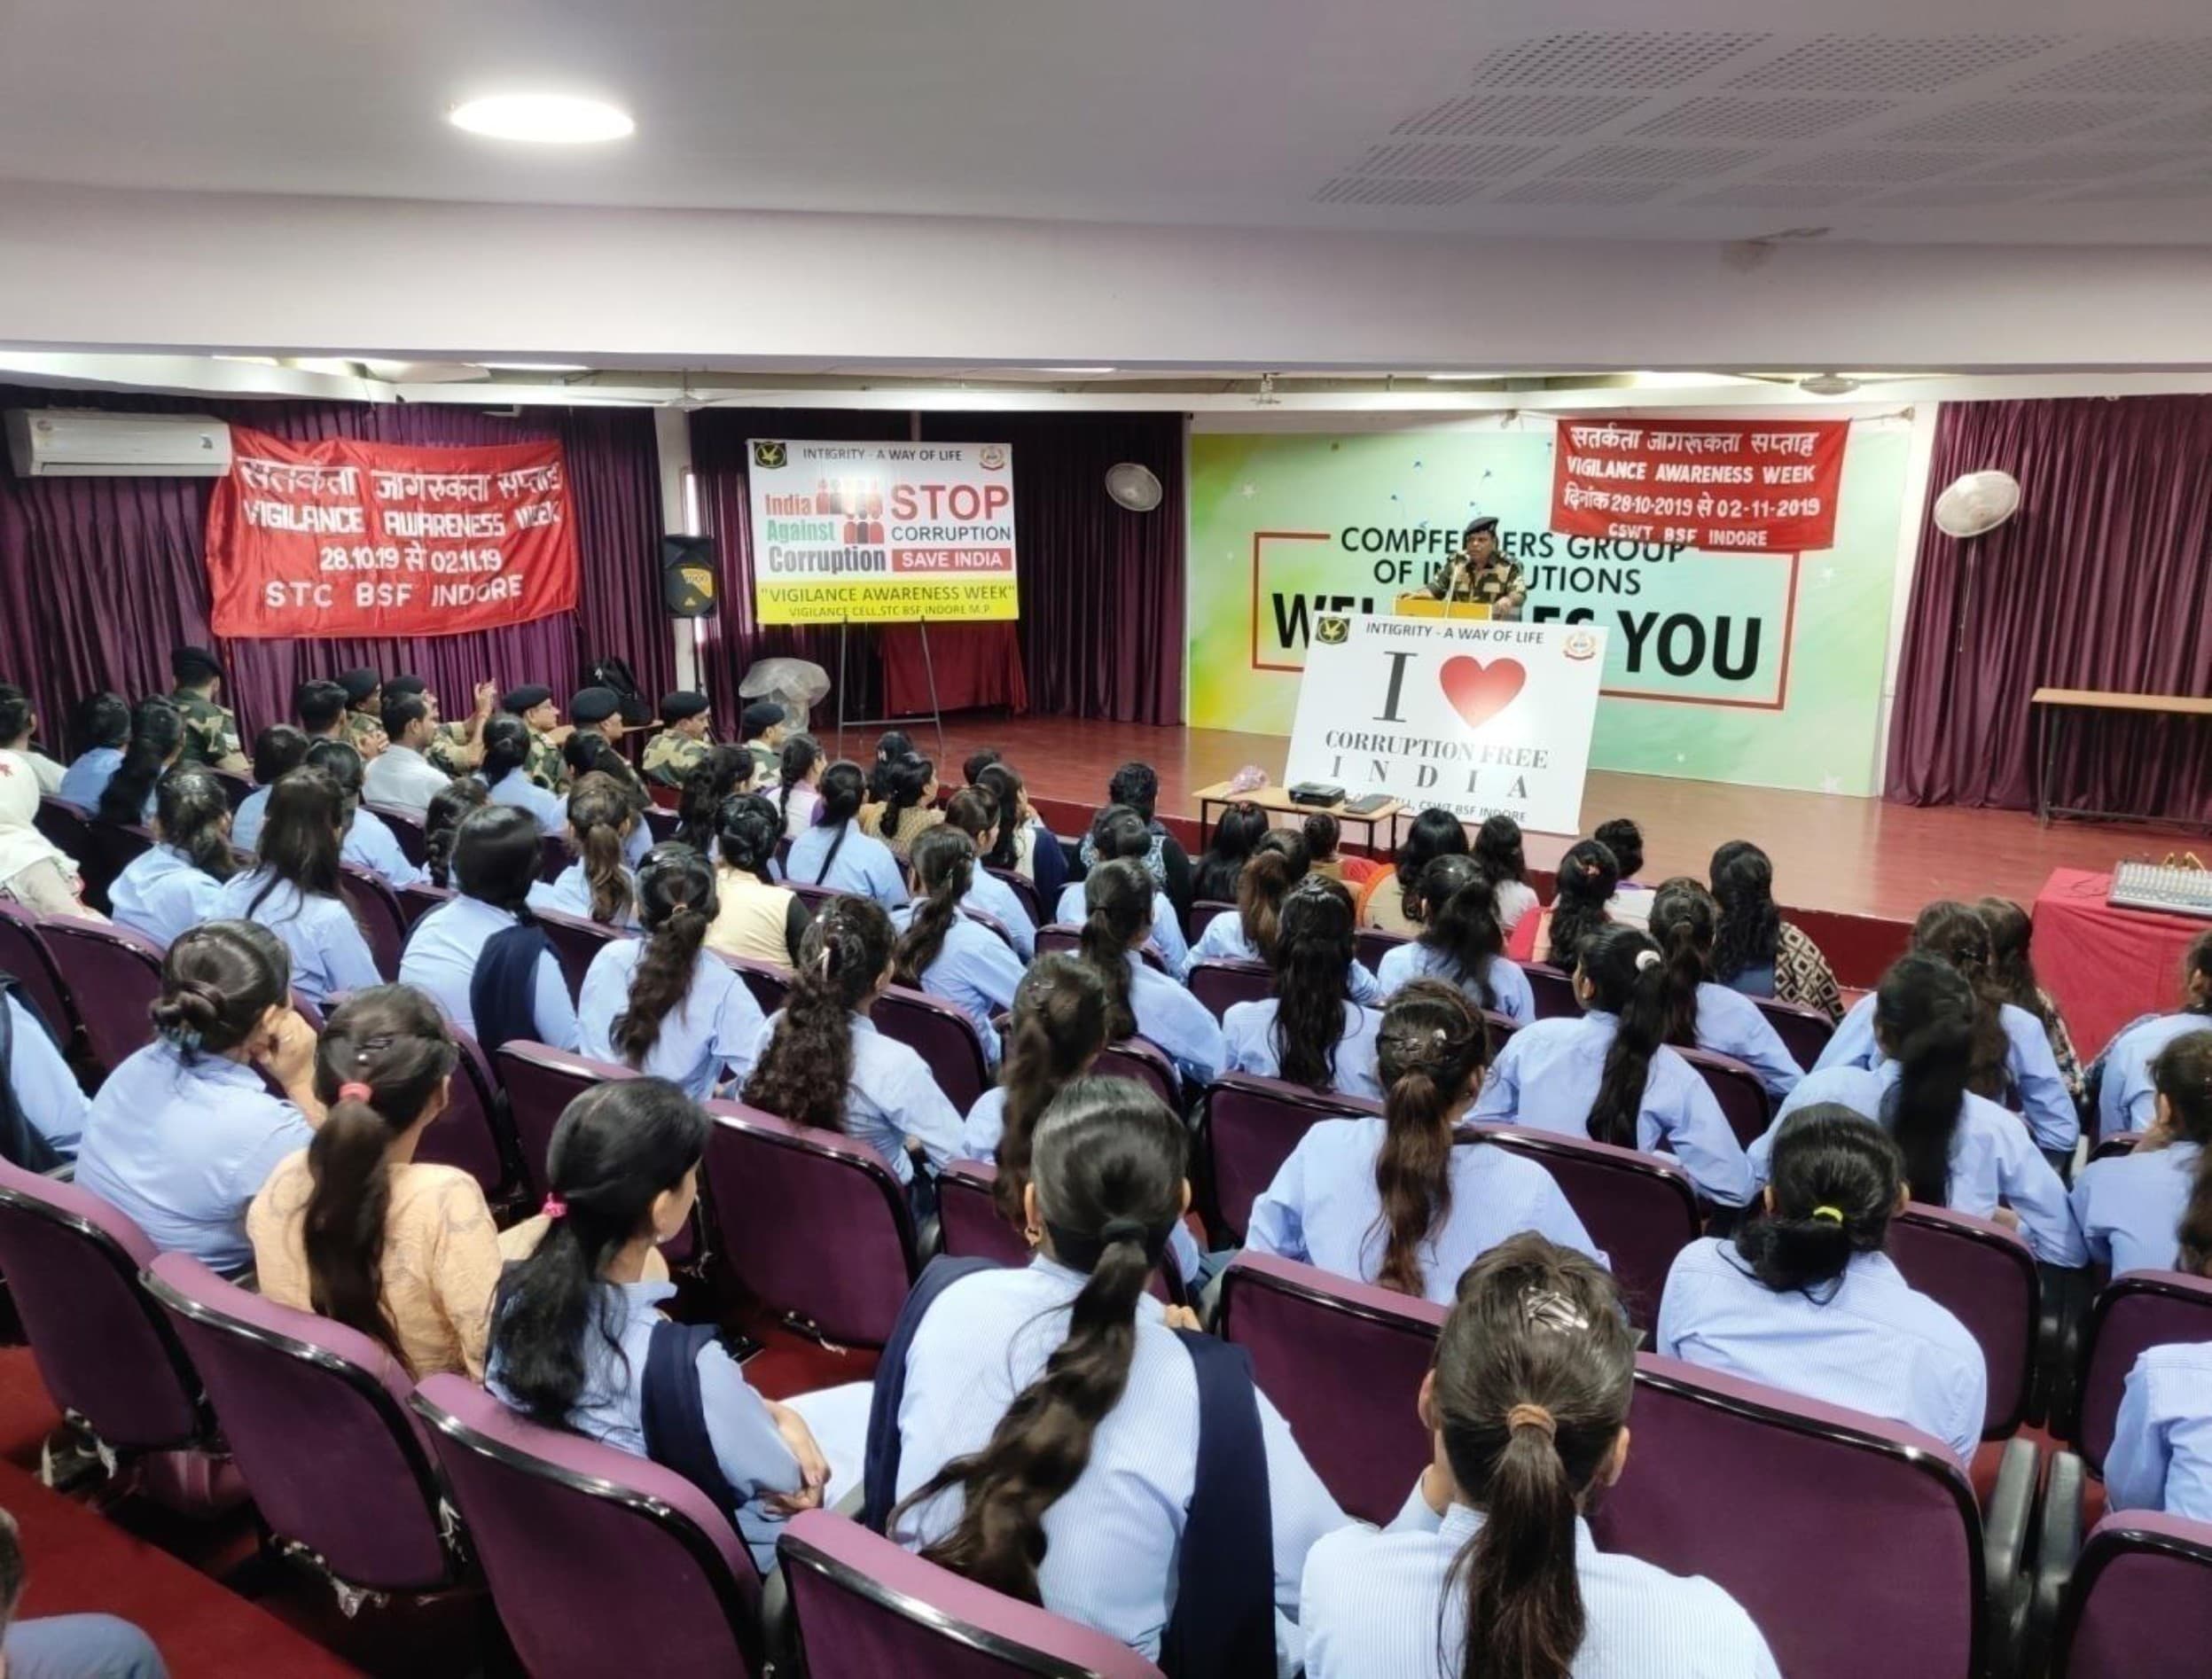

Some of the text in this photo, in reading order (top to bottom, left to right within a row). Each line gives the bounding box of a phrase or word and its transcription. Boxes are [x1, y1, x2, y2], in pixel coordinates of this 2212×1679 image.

[1570, 422, 1643, 451] सतर्कता
[1751, 432, 1819, 457] सप्ताह
[802, 448, 865, 460] INTIGRITY
[877, 449, 886, 459] A
[888, 449, 916, 461] WAY
[919, 450, 935, 461] OF
[939, 450, 962, 461] LIFE
[1567, 456, 1816, 484] VIGILANCE AWARENESS WEEK
[765, 494, 812, 516] India
[890, 485, 1010, 521] STOP
[1564, 485, 1610, 511] दिनांक
[1697, 491, 1713, 519] से
[244, 500, 365, 534] VIGILANCE
[384, 511, 505, 537] AWARENESS
[767, 519, 835, 543] Against
[891, 526, 1012, 542] CORRUPTION
[1341, 527, 1553, 558] COMPFEERS
[1608, 522, 1768, 546] CSWT BSF INDORE
[320, 540, 503, 573] 28.10.19 से 02.11.19
[769, 546, 886, 574] Corruption
[902, 551, 1003, 568] SAVE INDIA
[1375, 560, 1413, 584] OF
[266, 574, 523, 607] STC BSF INDORE
[863, 586, 959, 601] AWARENESS
[789, 607, 847, 618] VIGILANCE
[1366, 622, 1433, 636] INTIGRITY
[1443, 626, 1453, 638] A
[1456, 627, 1489, 641] WAY
[1493, 629, 1513, 643] OF
[1516, 631, 1545, 644] LIFE
[1616, 610, 1762, 680] YOU
[1372, 651, 1419, 722] I
[1325, 730, 1549, 769] CORRUPTION FREE
[1456, 803, 1478, 816] BSF
[1480, 808, 1527, 822] INDORE
